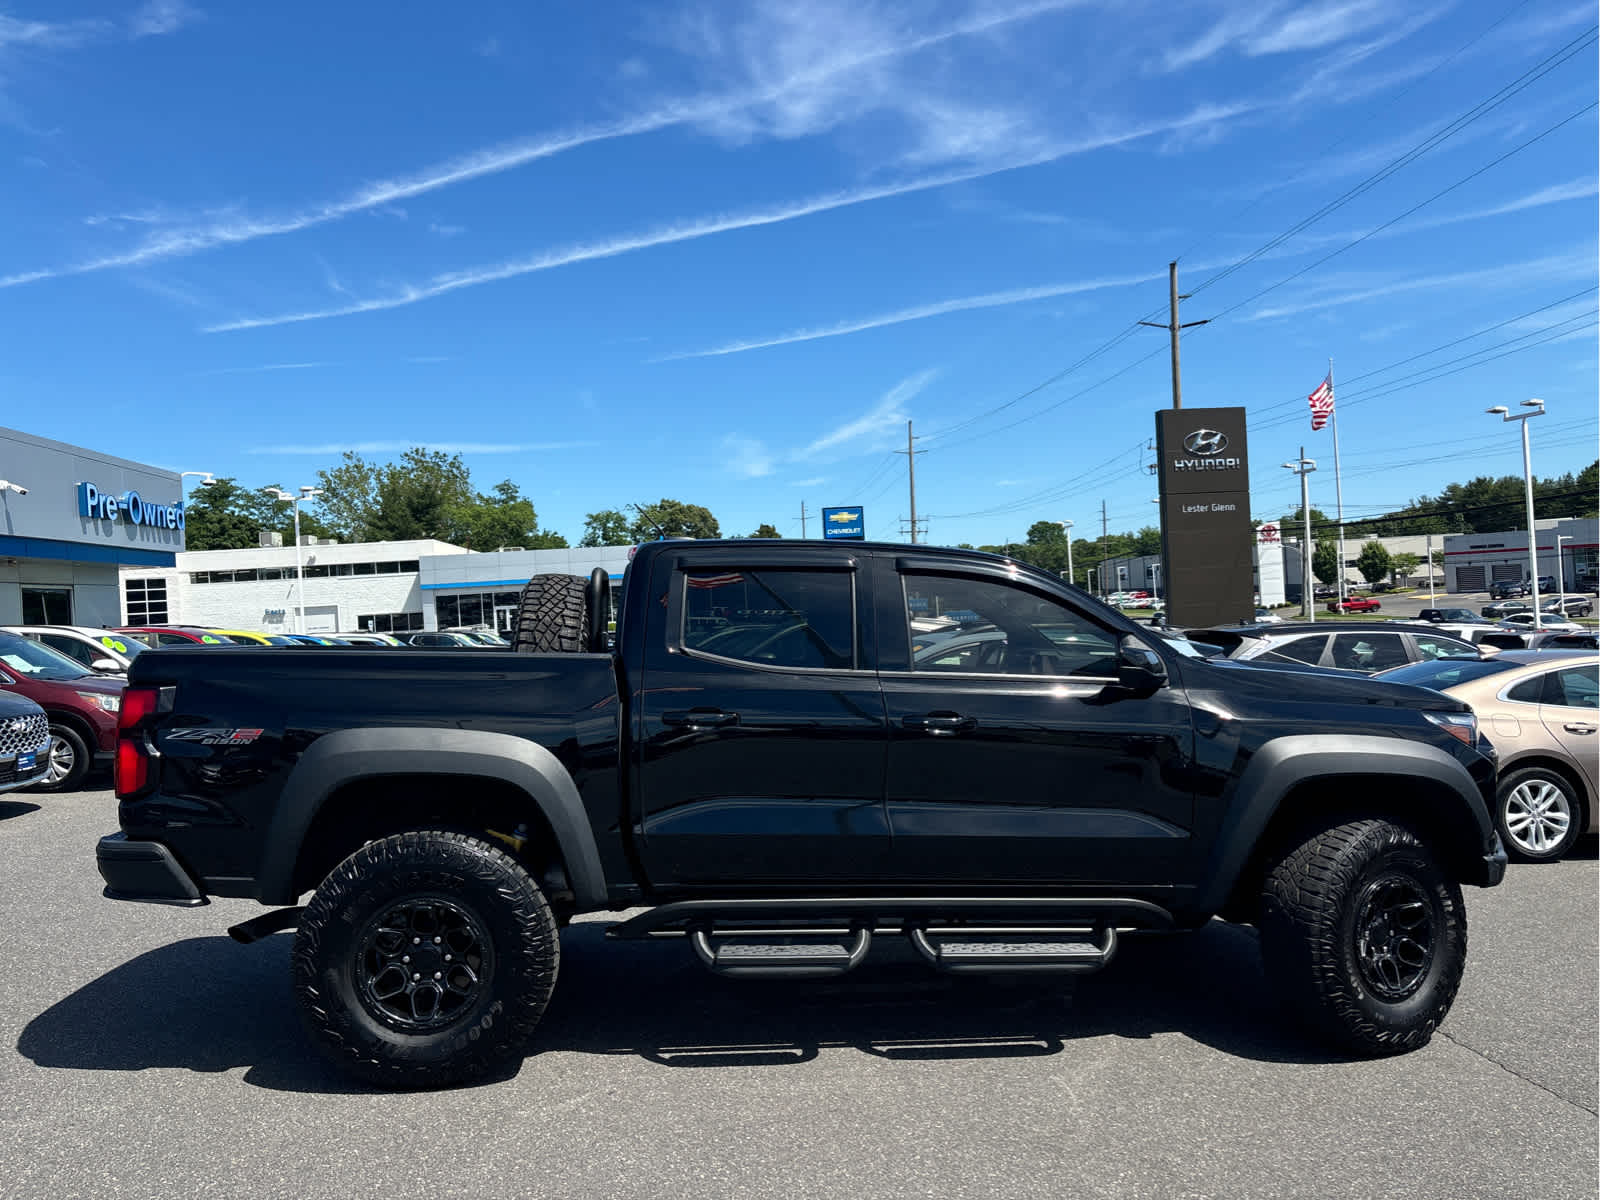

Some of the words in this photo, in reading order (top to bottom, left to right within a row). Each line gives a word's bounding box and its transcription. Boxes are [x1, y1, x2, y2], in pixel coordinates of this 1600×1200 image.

[1174, 458, 1240, 470] HYUNDAI
[82, 482, 185, 531] Pre-Owned
[1182, 504, 1208, 512] Lester
[1211, 503, 1236, 511] Glenn
